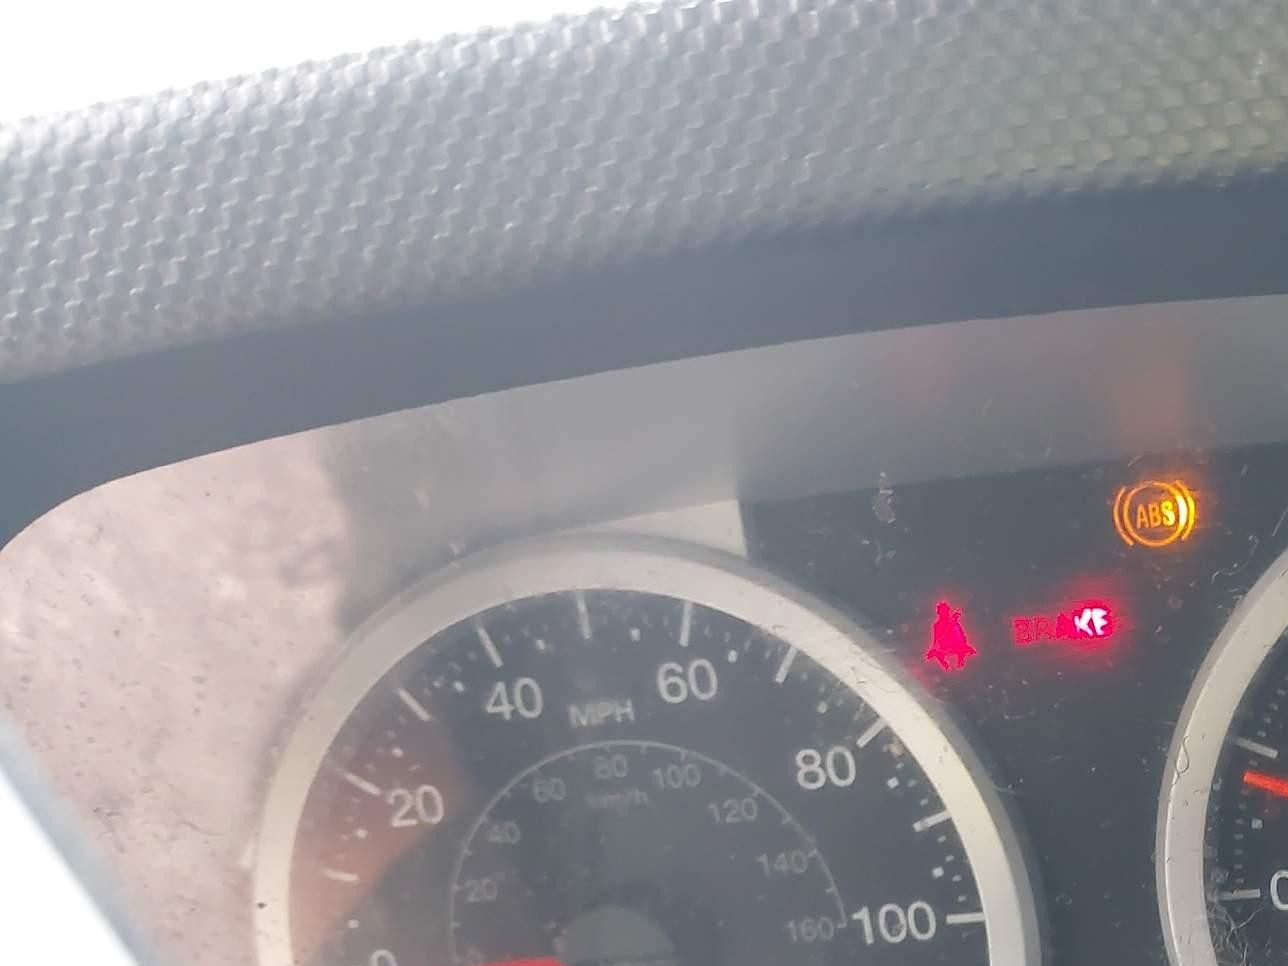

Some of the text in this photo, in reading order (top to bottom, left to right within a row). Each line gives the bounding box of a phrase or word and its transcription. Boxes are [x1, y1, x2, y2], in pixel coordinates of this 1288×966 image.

[1136, 500, 1176, 529] ABS
[657, 660, 718, 705] 60
[486, 678, 543, 720] 40
[568, 699, 635, 728] MPH
[653, 763, 700, 791] 100
[795, 746, 857, 790] 80
[532, 778, 566, 802] 60
[389, 785, 445, 828] 20
[709, 799, 757, 824] 120
[488, 821, 521, 845] 40
[757, 850, 808, 876] 140
[466, 879, 498, 902] 20
[786, 917, 834, 942] 160
[852, 902, 937, 944] 100
